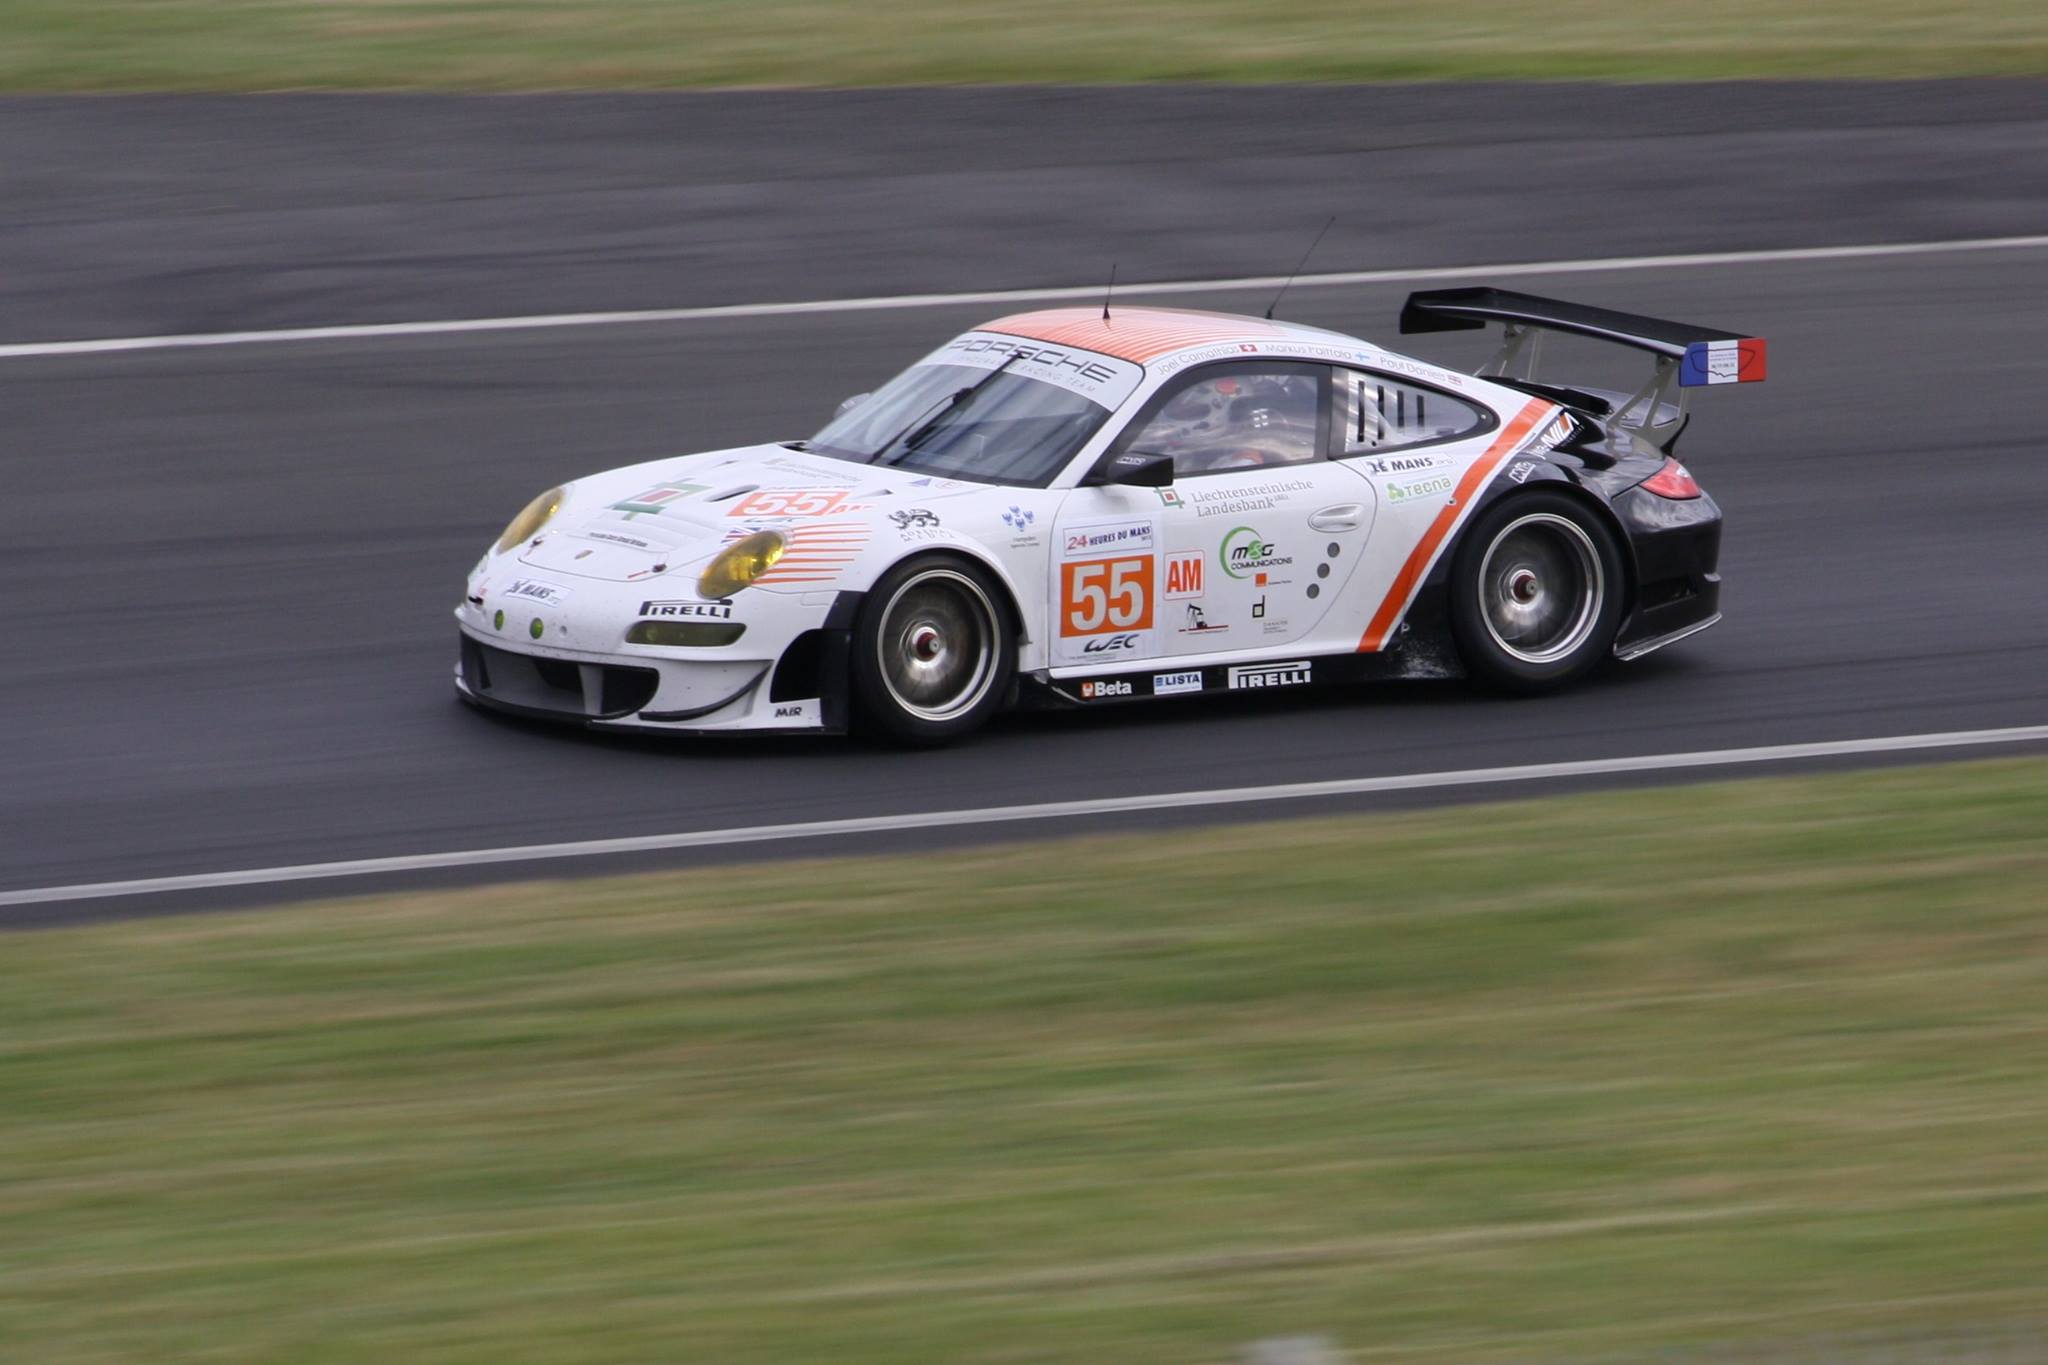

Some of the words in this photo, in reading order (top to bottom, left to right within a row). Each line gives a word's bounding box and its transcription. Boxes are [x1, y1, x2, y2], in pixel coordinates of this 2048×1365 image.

[949, 339, 1118, 384] PORSCHE
[1379, 356, 1405, 372] Paul
[1390, 457, 1433, 471] MANS
[1191, 479, 1314, 503] Liechtensteinische
[742, 492, 830, 515] 55
[1196, 496, 1276, 518] Landesbank
[1066, 535, 1088, 550] 24
[1089, 533, 1116, 546] HEURES
[1117, 530, 1128, 540] DU
[1129, 526, 1150, 537] MANS
[1231, 556, 1293, 570] COMMUNICATIONS
[1166, 558, 1201, 593] AM
[1070, 559, 1145, 631] 55
[638, 599, 734, 619] PIRELLI
[1083, 633, 1140, 653] WEC
[1165, 673, 1200, 686] LISTA
[1228, 660, 1312, 689] PIRELLI
[1094, 680, 1133, 697] Beta
